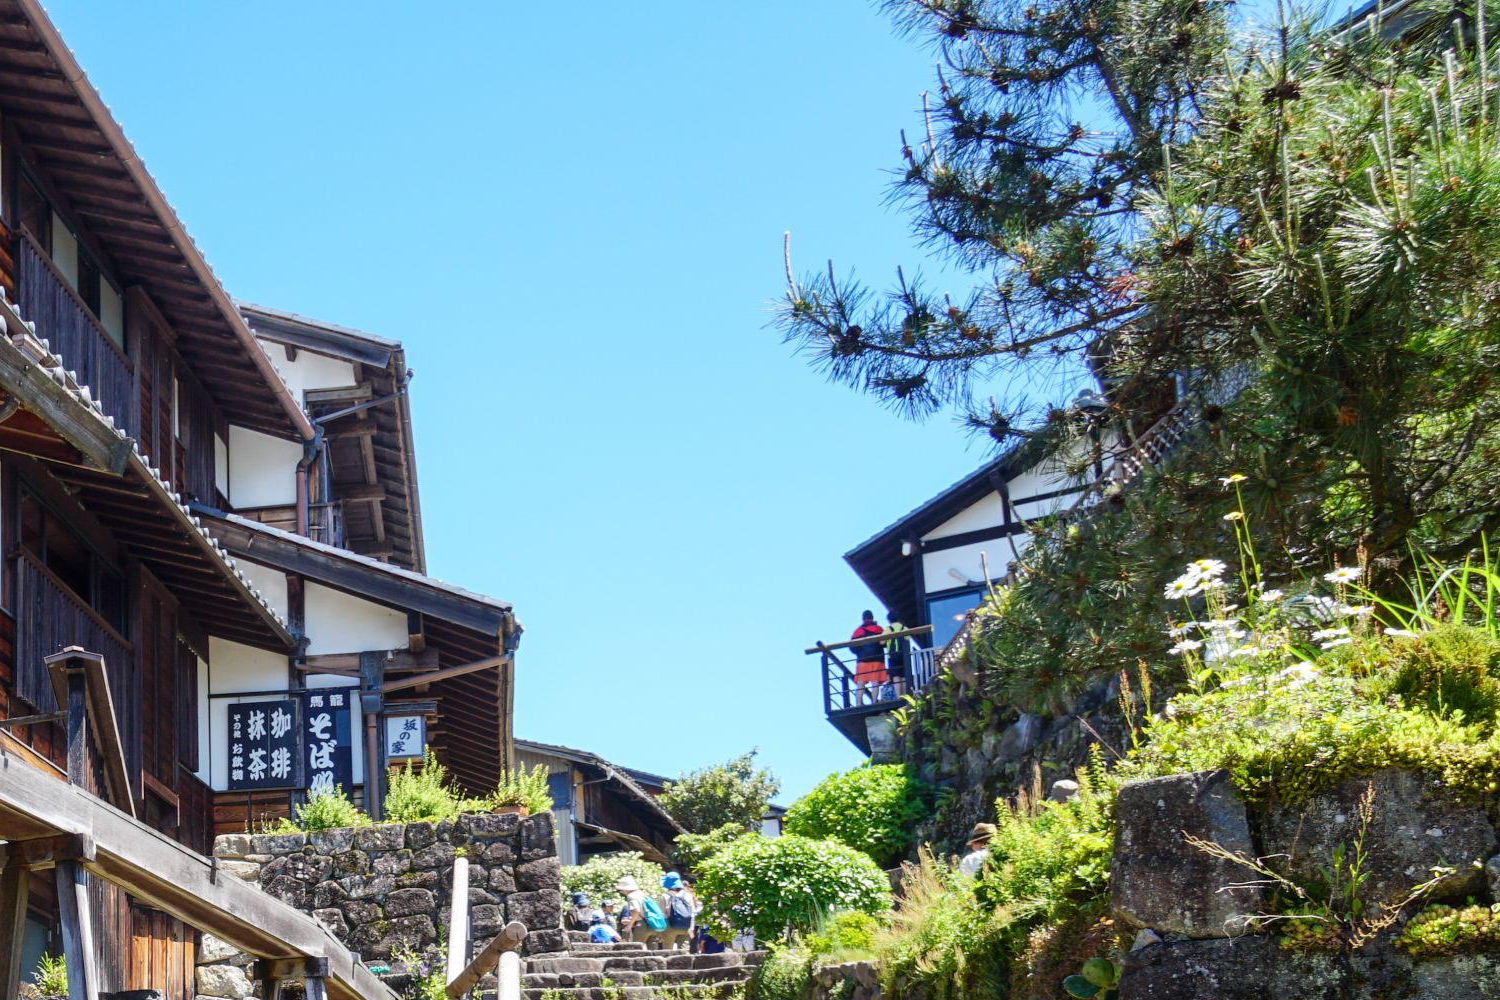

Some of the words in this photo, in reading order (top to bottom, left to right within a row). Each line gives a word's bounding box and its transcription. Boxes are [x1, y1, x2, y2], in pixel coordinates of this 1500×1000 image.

[310, 694, 343, 708] 馬籠
[247, 710, 267, 780] 抹茶
[270, 707, 291, 780] 珈琲
[391, 718, 418, 754] 坂の家
